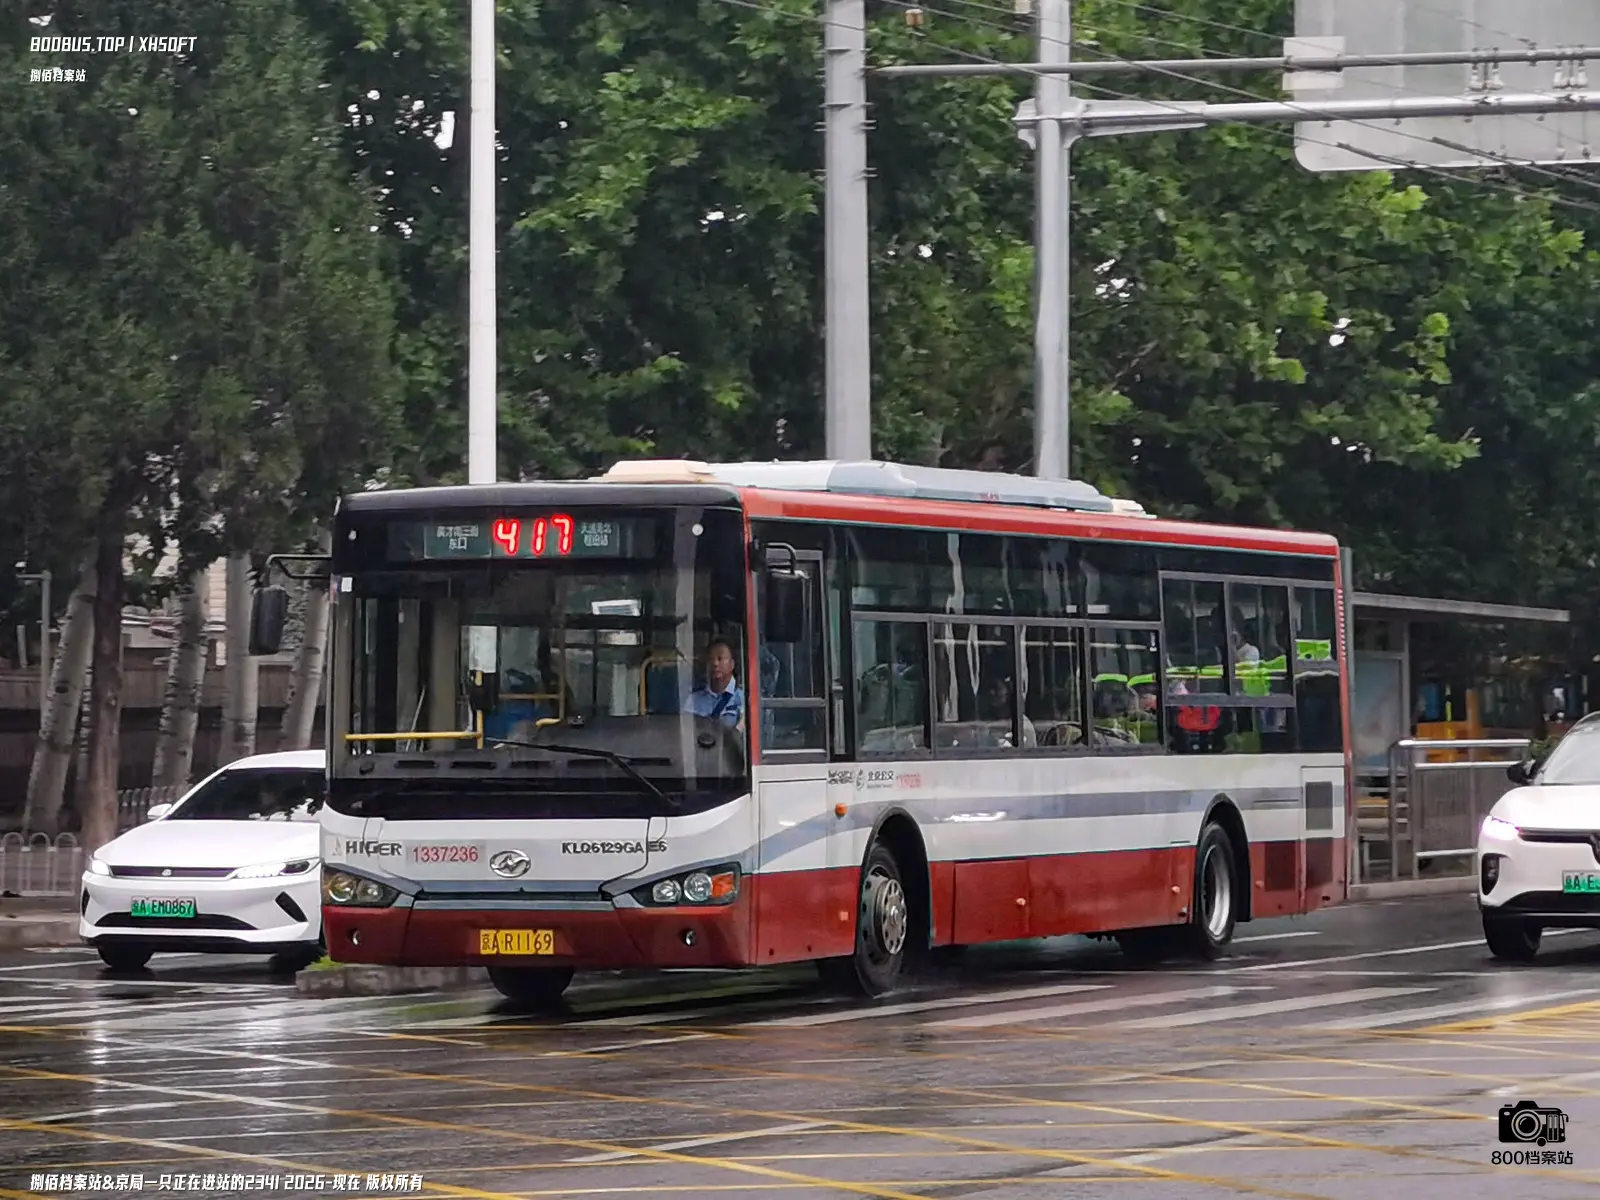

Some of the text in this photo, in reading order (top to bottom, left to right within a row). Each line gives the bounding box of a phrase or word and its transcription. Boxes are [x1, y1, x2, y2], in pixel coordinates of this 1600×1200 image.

[494, 515, 573, 555] 417
[345, 840, 402, 856] HIGER
[412, 845, 478, 863] 1337236
